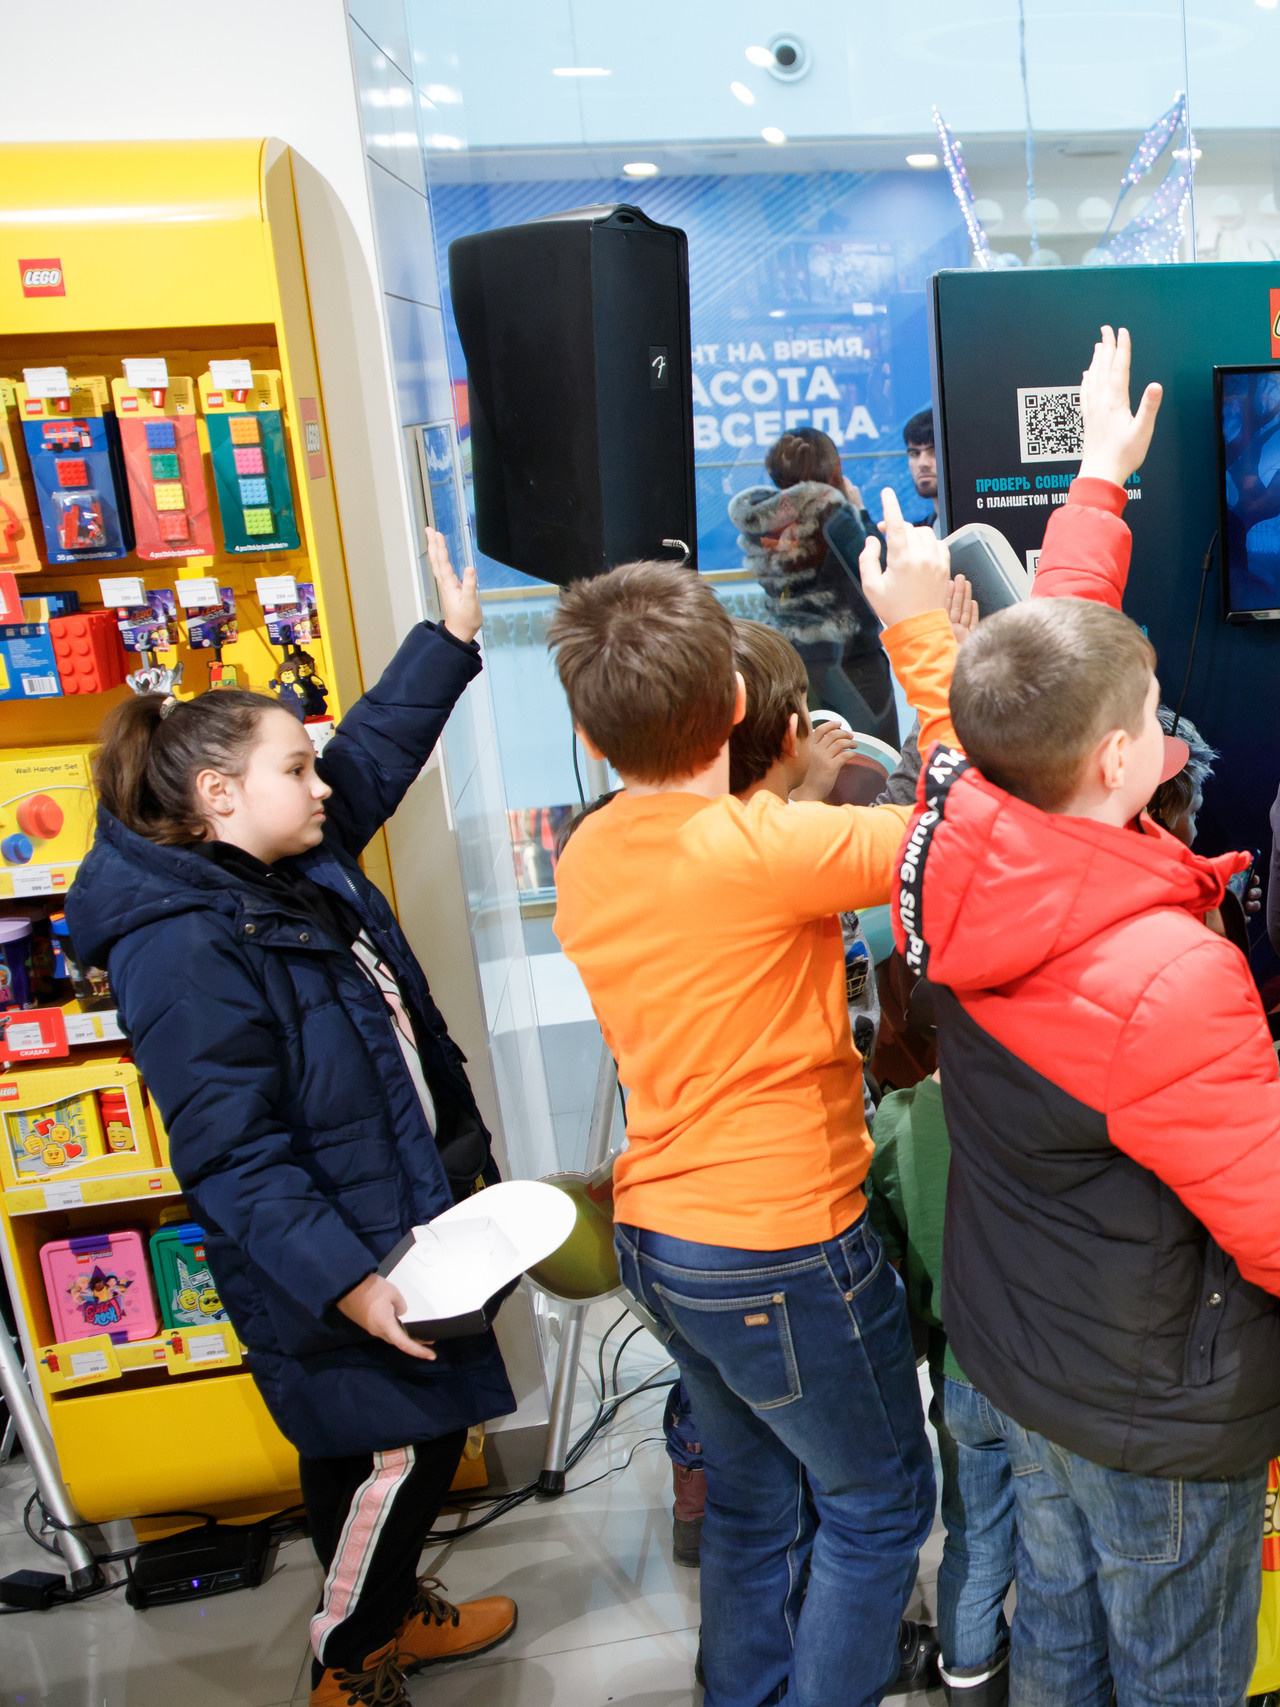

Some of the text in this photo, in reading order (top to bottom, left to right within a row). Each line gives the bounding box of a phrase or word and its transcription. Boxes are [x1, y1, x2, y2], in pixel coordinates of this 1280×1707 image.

[24, 269, 60, 286] LEGO
[728, 343, 766, 363] НА
[774, 337, 871, 360] ВРЕМЯ,
[976, 477, 1030, 493] ПРОВЕРЬ
[977, 498, 983, 508] С
[987, 495, 1049, 508] ПЛАНШЕТОМ
[33, 765, 61, 773] Hanger
[20, 1049, 50, 1057] СКИДКА!
[0, 1088, 17, 1096] LEGO
